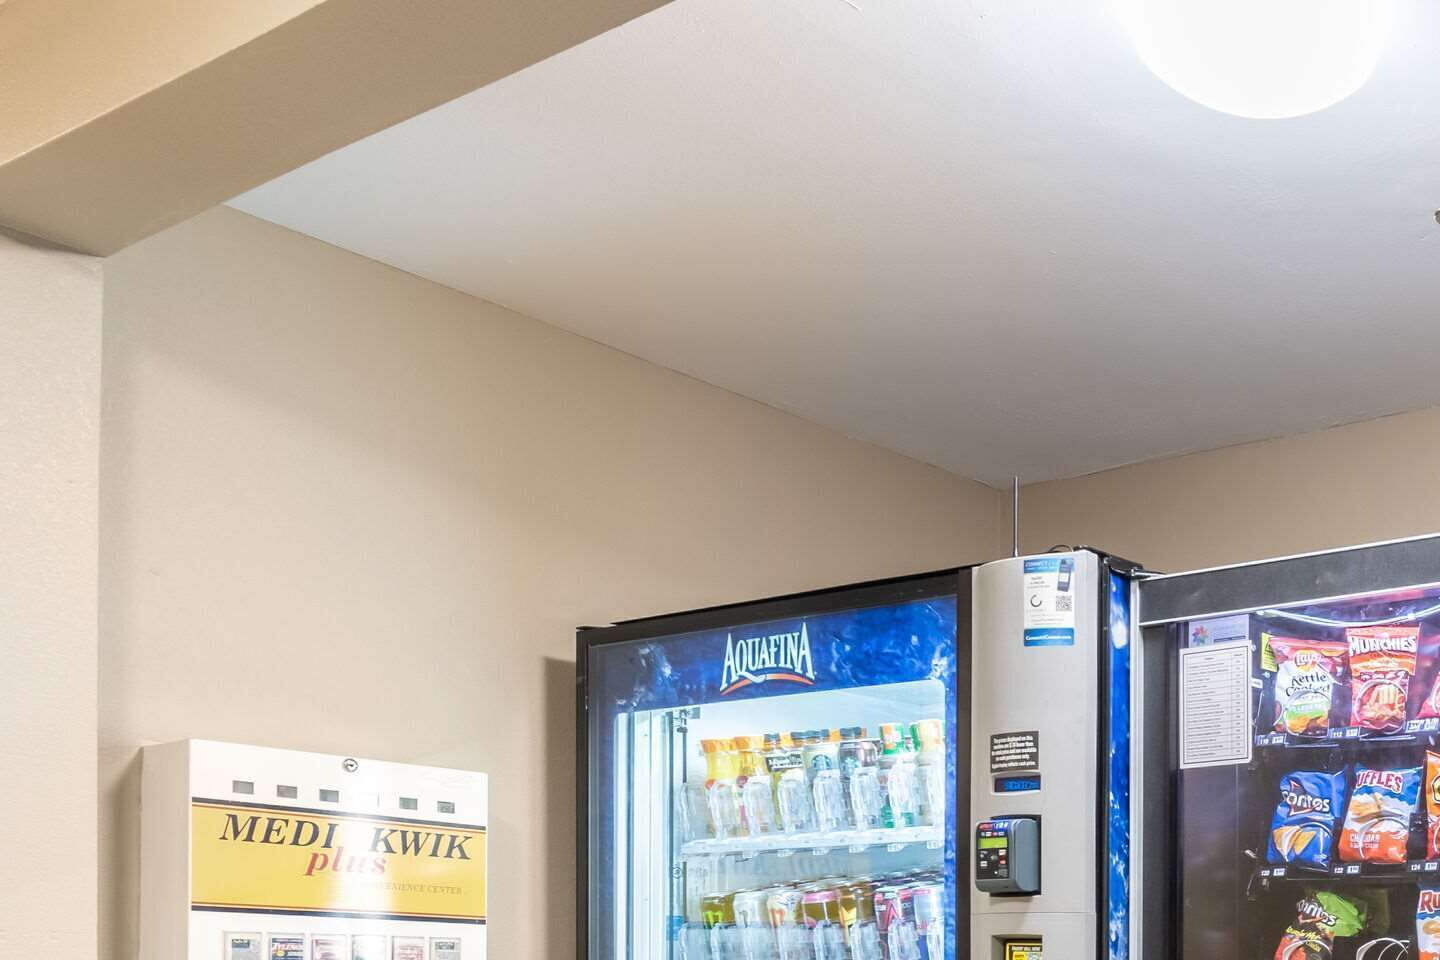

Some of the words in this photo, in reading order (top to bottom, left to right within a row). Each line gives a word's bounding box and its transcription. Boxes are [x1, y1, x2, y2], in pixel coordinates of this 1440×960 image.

[720, 621, 816, 693] AQUAFINA
[1349, 635, 1417, 656] MUNCHIES
[1291, 671, 1328, 687] Kettle
[1356, 770, 1403, 793] UFFLES
[218, 812, 339, 849] MEDI
[370, 827, 473, 860] KWIK
[304, 846, 387, 877] plus
